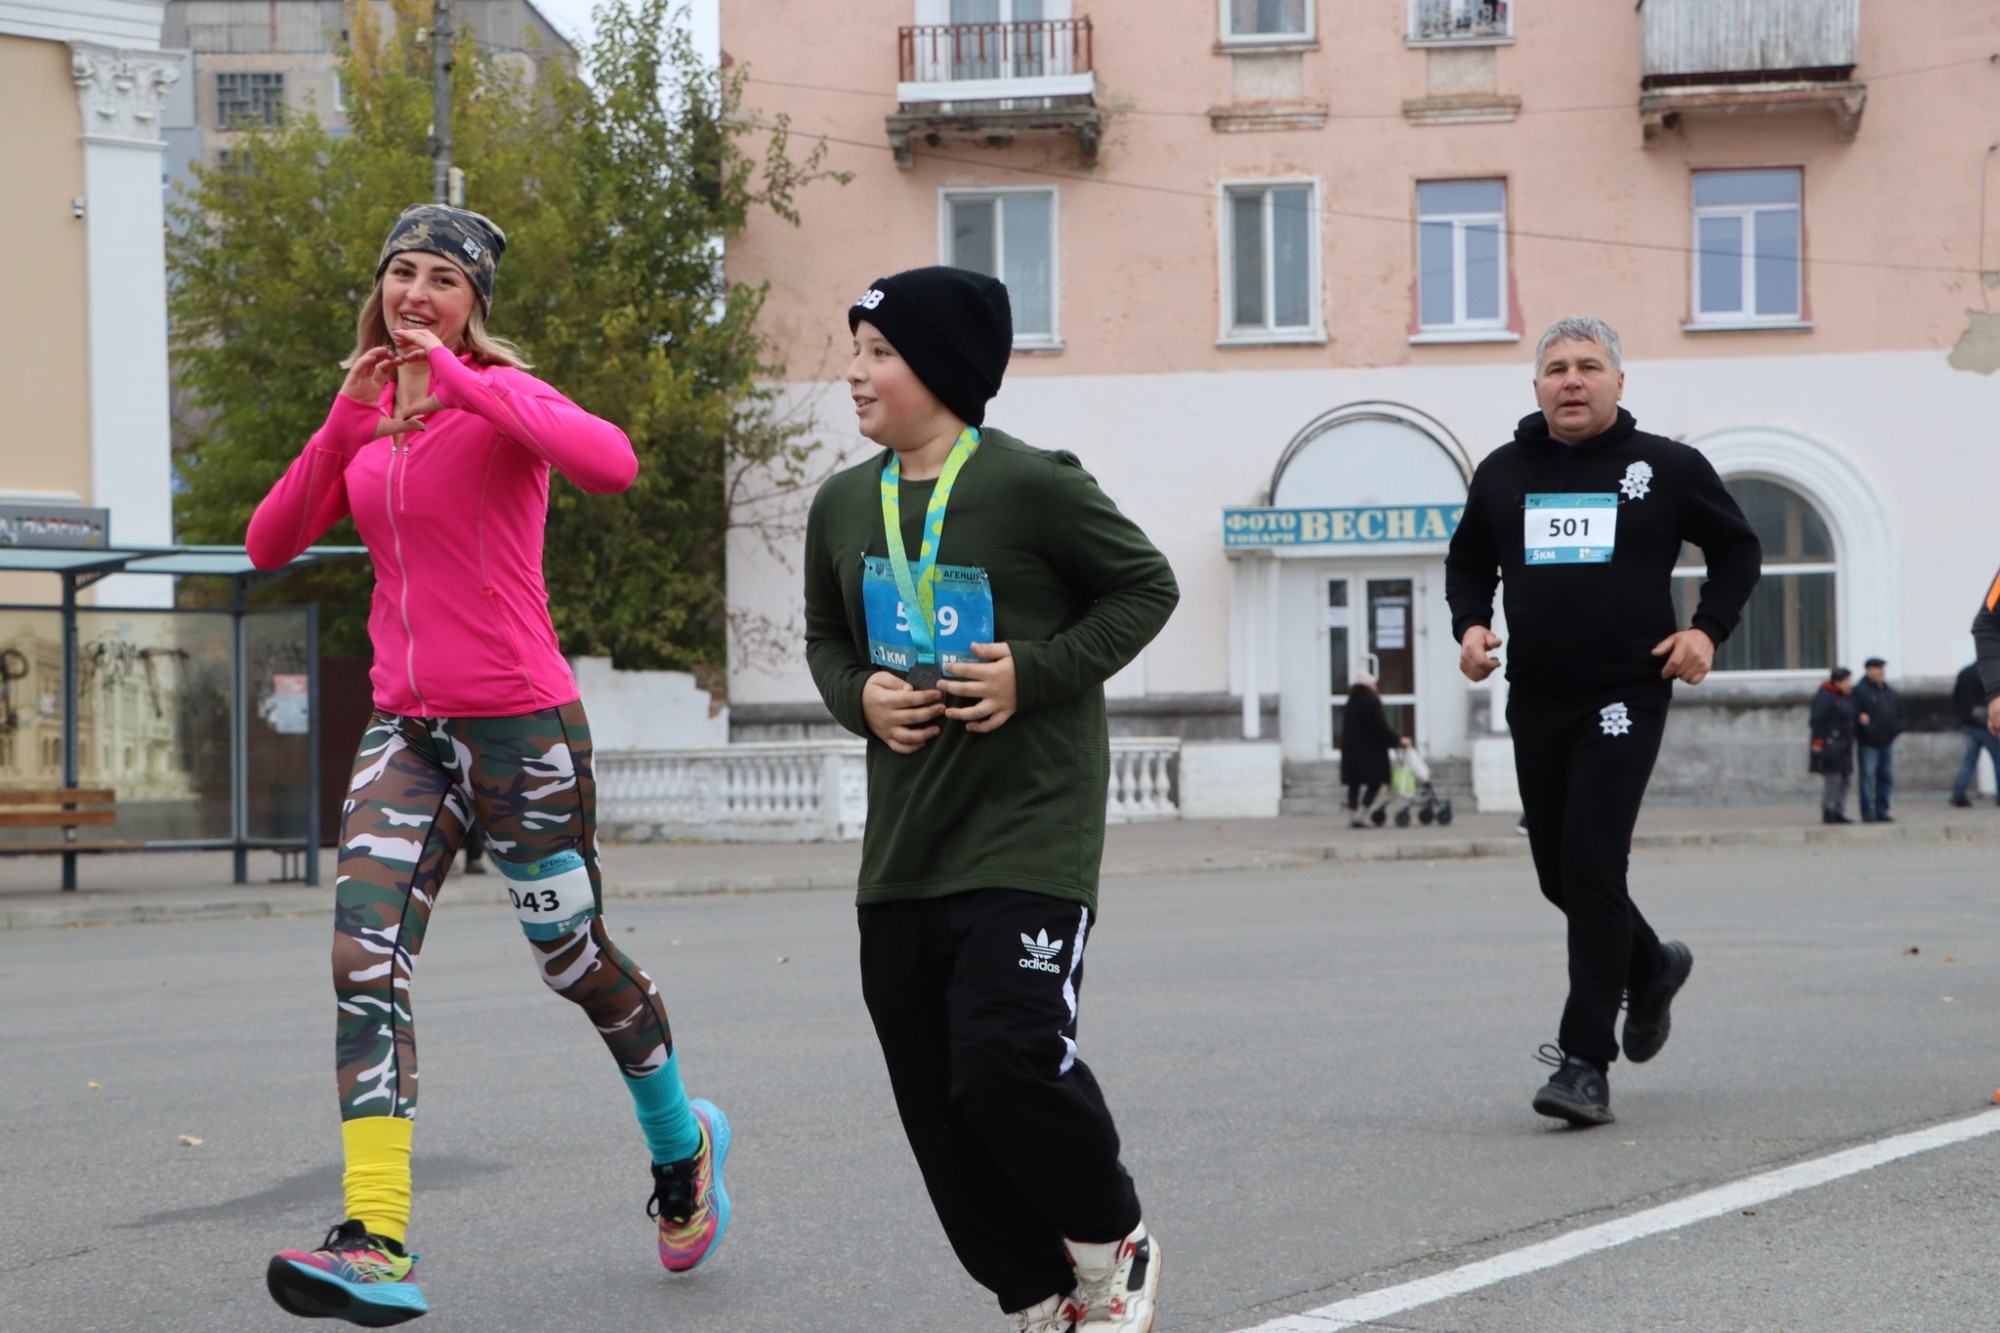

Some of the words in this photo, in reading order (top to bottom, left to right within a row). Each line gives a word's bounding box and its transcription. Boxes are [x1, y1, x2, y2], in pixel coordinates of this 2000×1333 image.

[1226, 512, 1297, 532] ФОТО
[1301, 508, 1448, 542] ВЕСНА
[1548, 518, 1590, 537] 501
[895, 601, 959, 636] 59
[509, 888, 560, 912] 043
[1018, 957, 1061, 974] adidas
